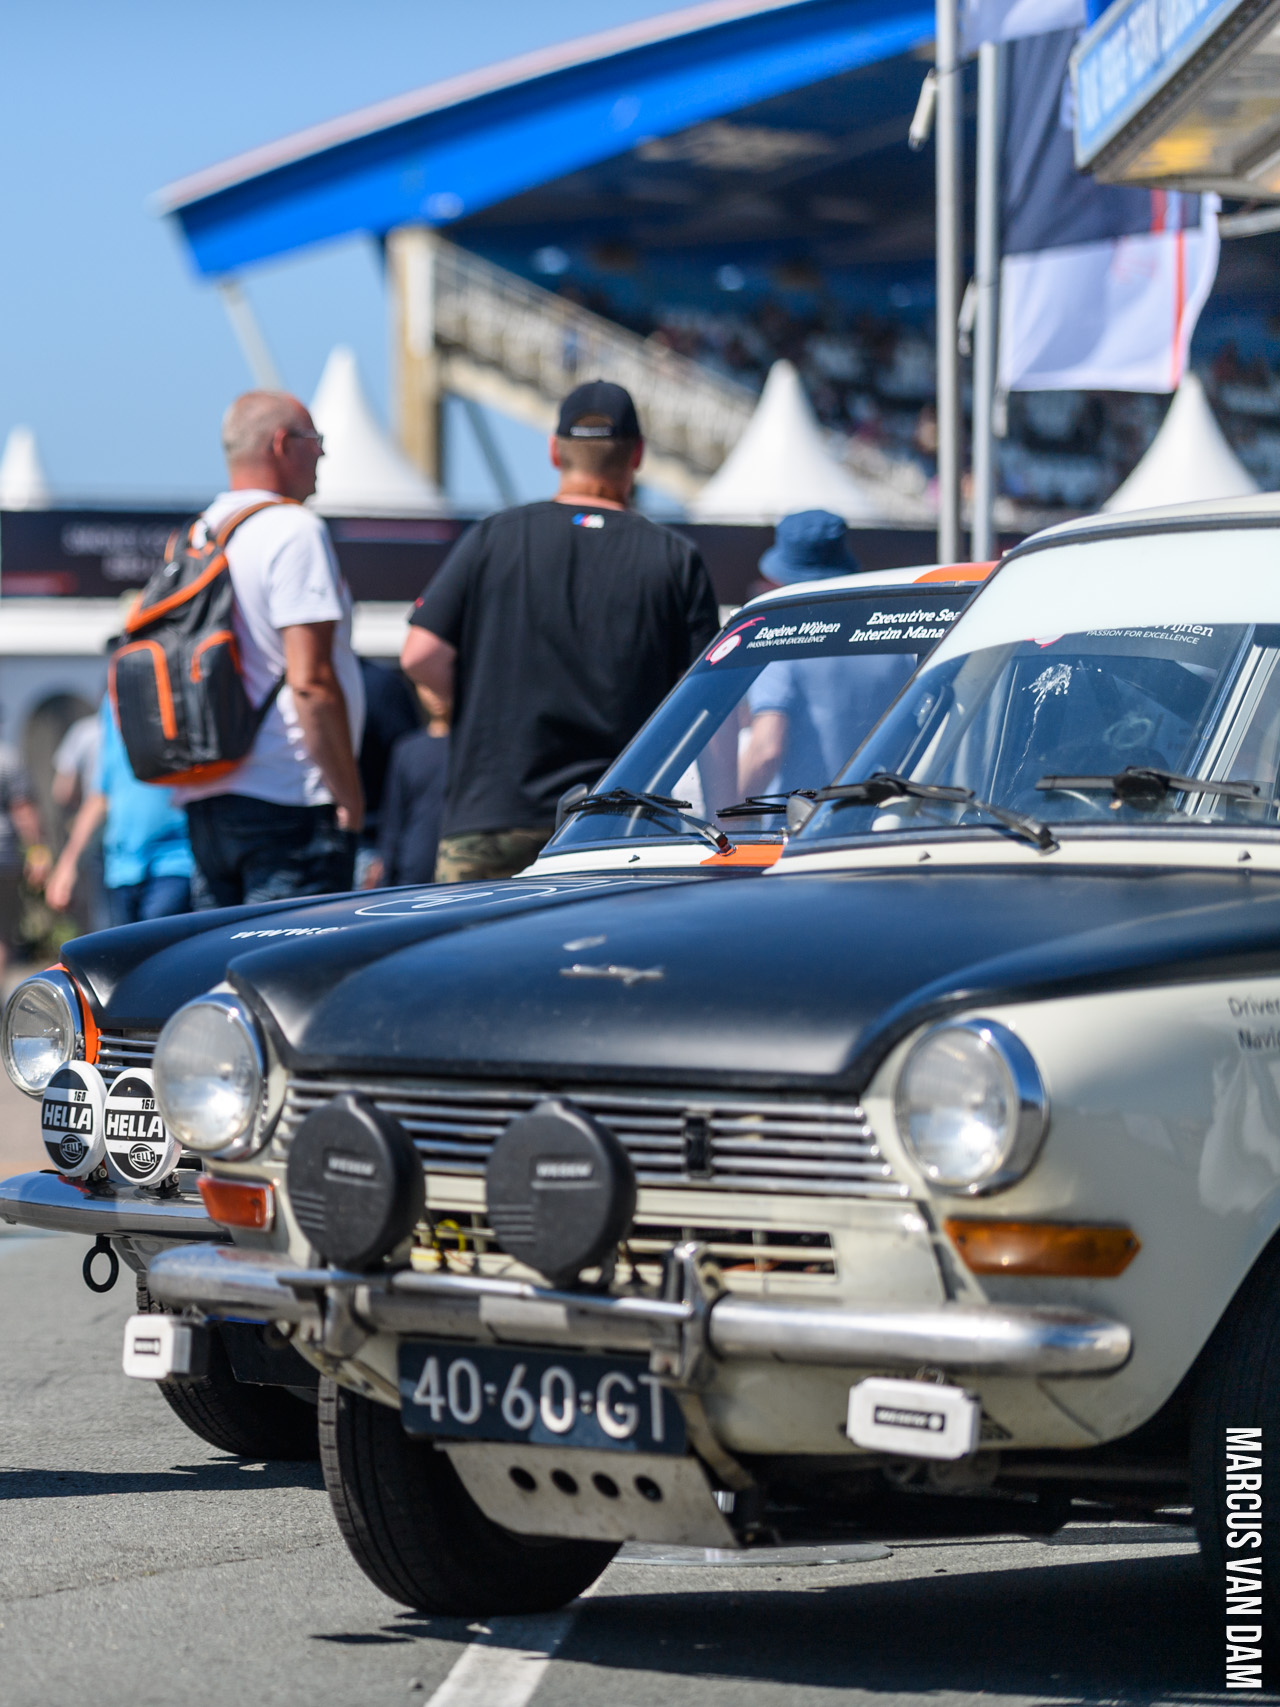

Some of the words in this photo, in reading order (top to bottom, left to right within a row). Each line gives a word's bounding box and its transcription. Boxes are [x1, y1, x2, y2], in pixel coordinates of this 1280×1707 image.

[866, 609, 936, 625] Executive
[798, 621, 841, 636] Wijnen
[849, 627, 903, 643] Interim
[902, 626, 948, 639] Mana
[786, 635, 827, 645] EXCELLENCE
[1124, 630, 1144, 638] FOR
[1143, 631, 1200, 645] EXCELLENCE
[74, 1091, 86, 1102] 160
[141, 1099, 155, 1110] 160
[43, 1103, 92, 1131] HELLA
[106, 1113, 163, 1138] HELLA
[130, 1151, 156, 1164] HELLA
